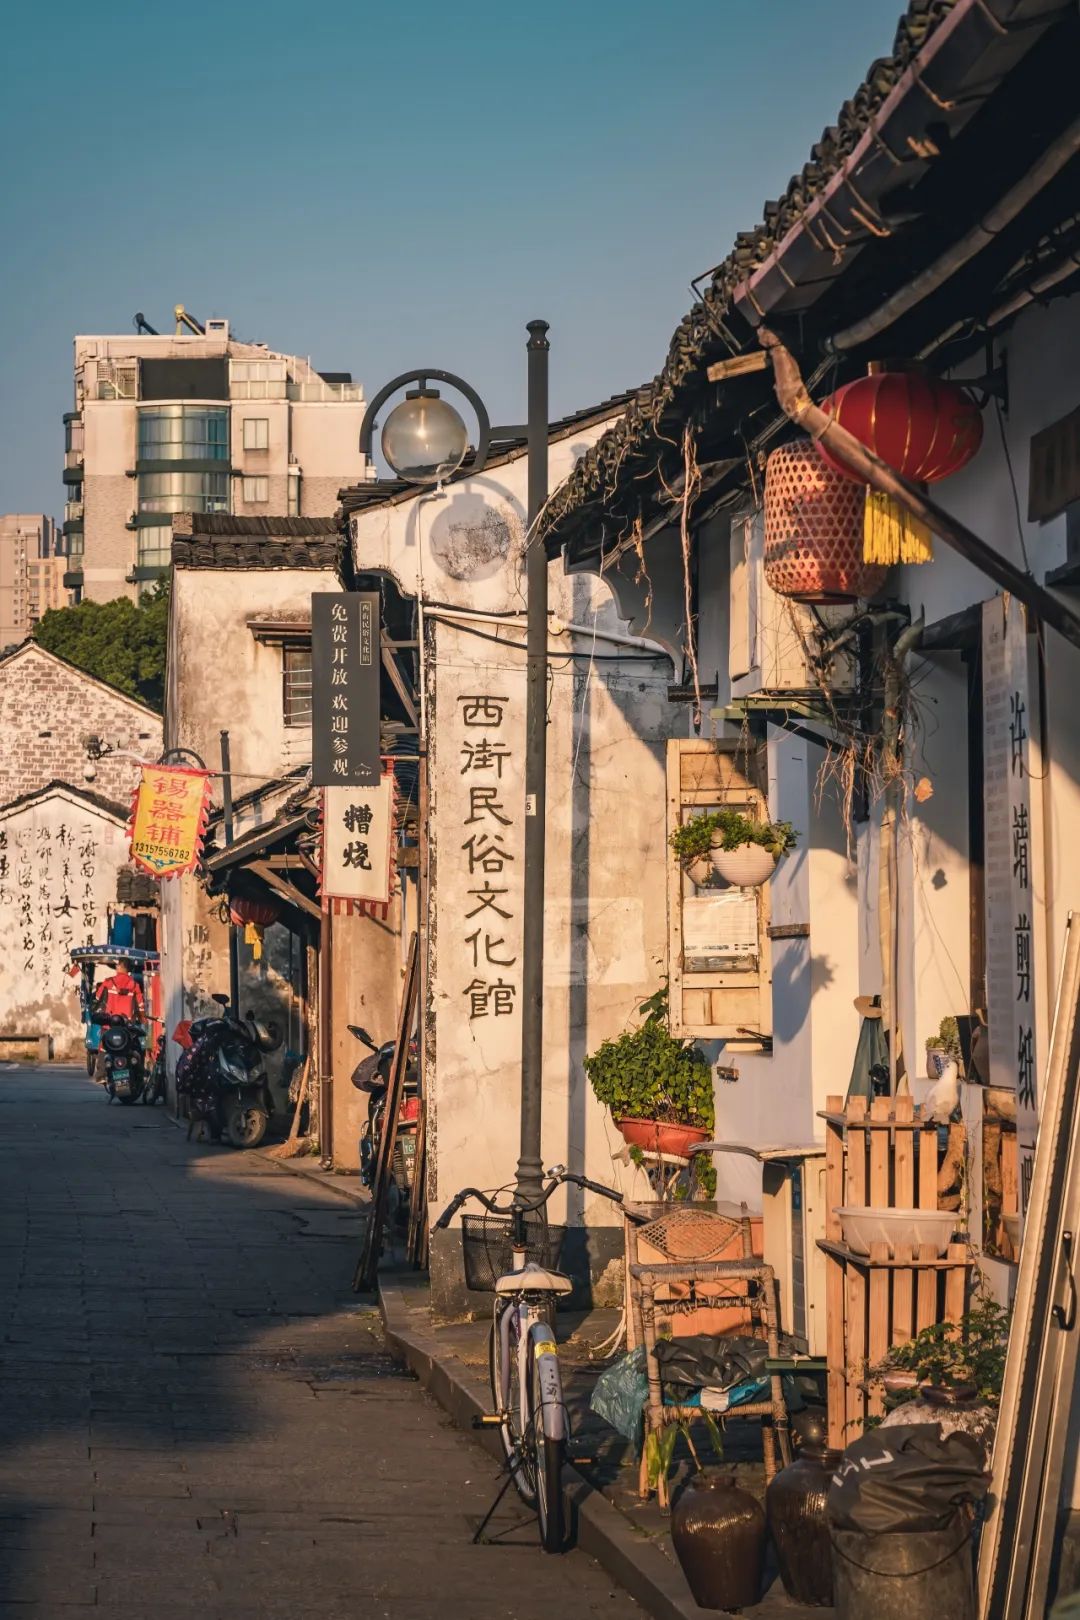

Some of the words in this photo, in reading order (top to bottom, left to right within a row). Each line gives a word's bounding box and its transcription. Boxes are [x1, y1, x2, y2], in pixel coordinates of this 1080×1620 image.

[135, 842, 190, 861] 13157556782
[342, 803, 374, 870] 糟烧
[456, 695, 518, 1019] 西街民俗文化館
